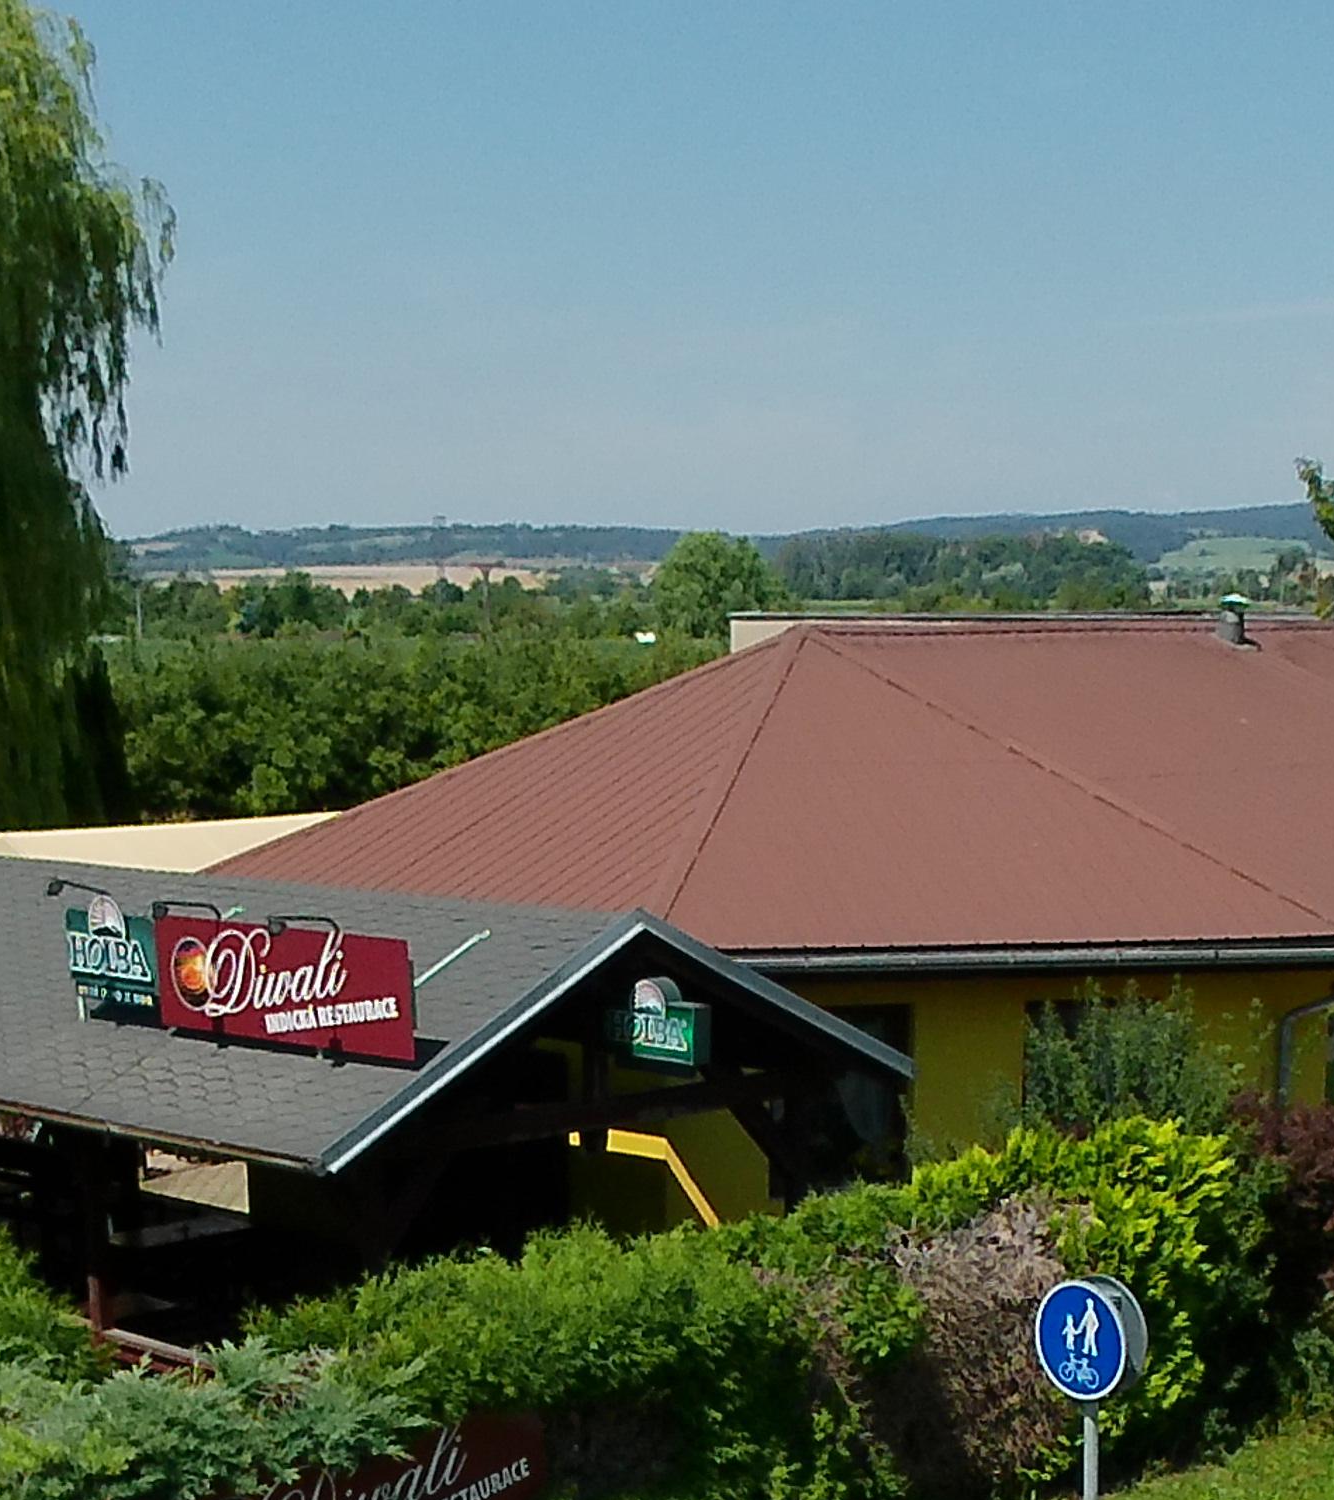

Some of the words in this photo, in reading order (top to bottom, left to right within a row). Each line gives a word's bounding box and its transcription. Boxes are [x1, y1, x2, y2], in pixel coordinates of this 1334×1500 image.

[67, 931, 151, 981] HOLBA
[205, 928, 348, 1017] Diwali
[265, 1004, 317, 1034] INDICKÁ
[318, 997, 399, 1028] RESTAURACE
[605, 1008, 688, 1052] HOLBA
